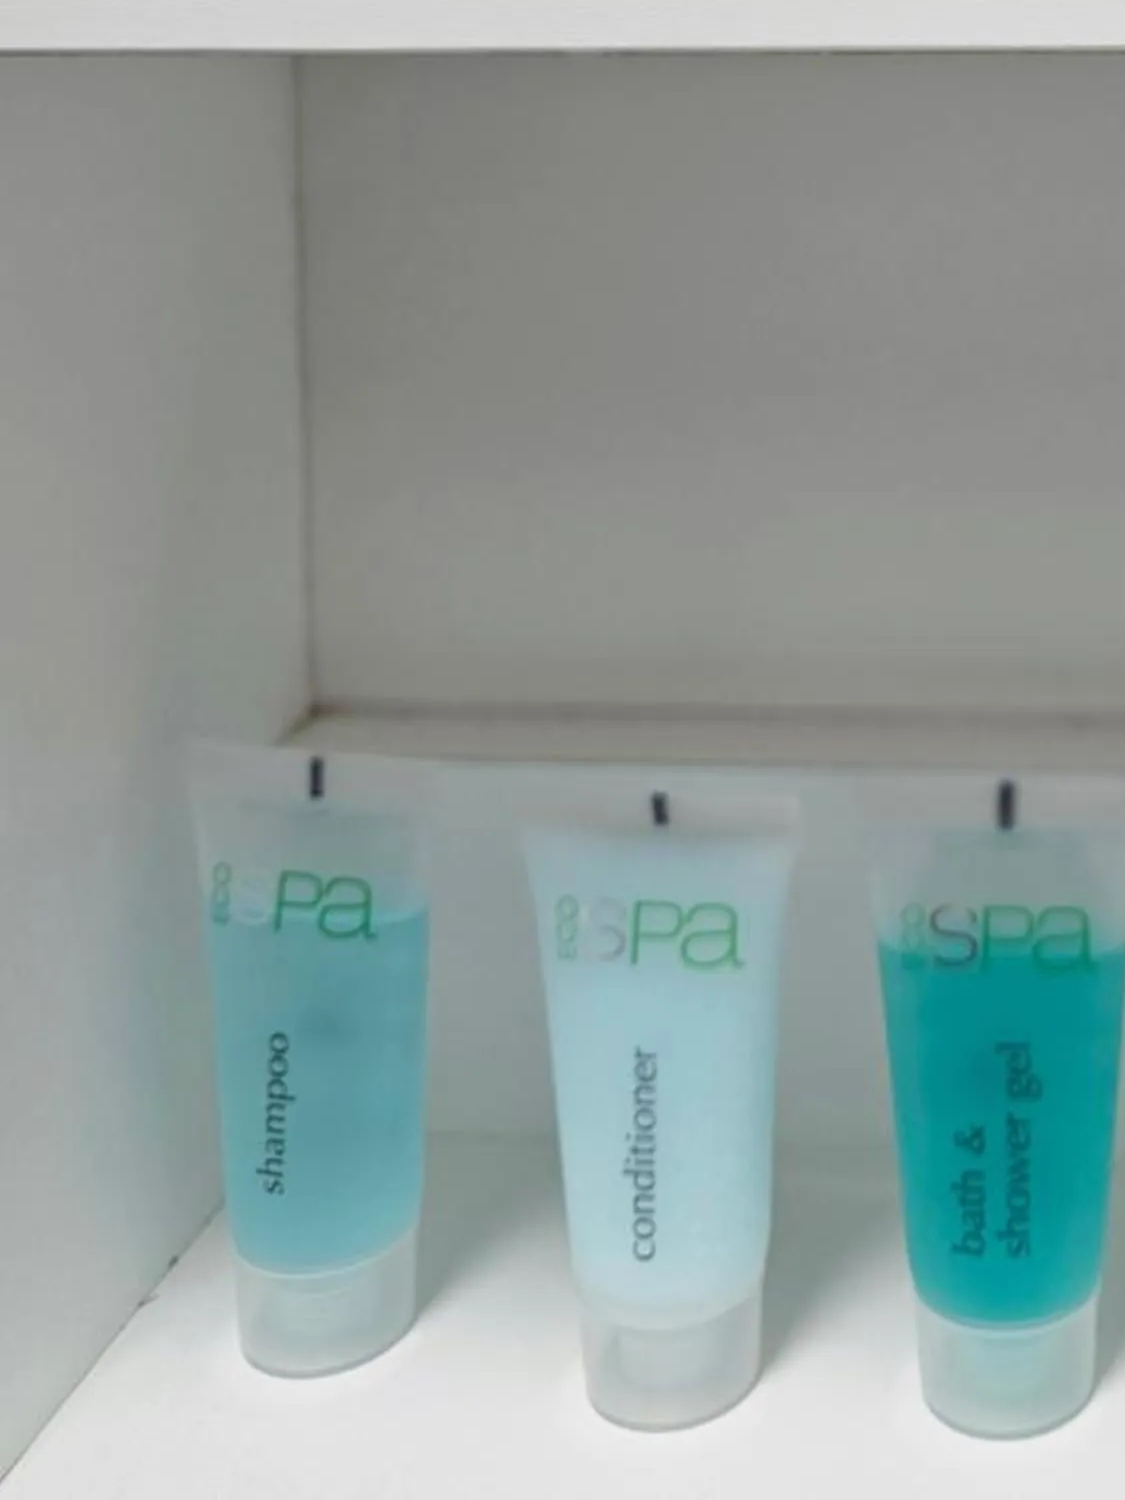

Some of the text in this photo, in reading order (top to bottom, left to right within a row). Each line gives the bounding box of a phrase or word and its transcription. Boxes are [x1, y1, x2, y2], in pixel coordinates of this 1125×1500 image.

[256, 1031, 296, 1196] shampoo
[622, 1046, 658, 1261] conditioner
[950, 1123, 987, 1259] bath &
[996, 1040, 1042, 1258] shower gel
